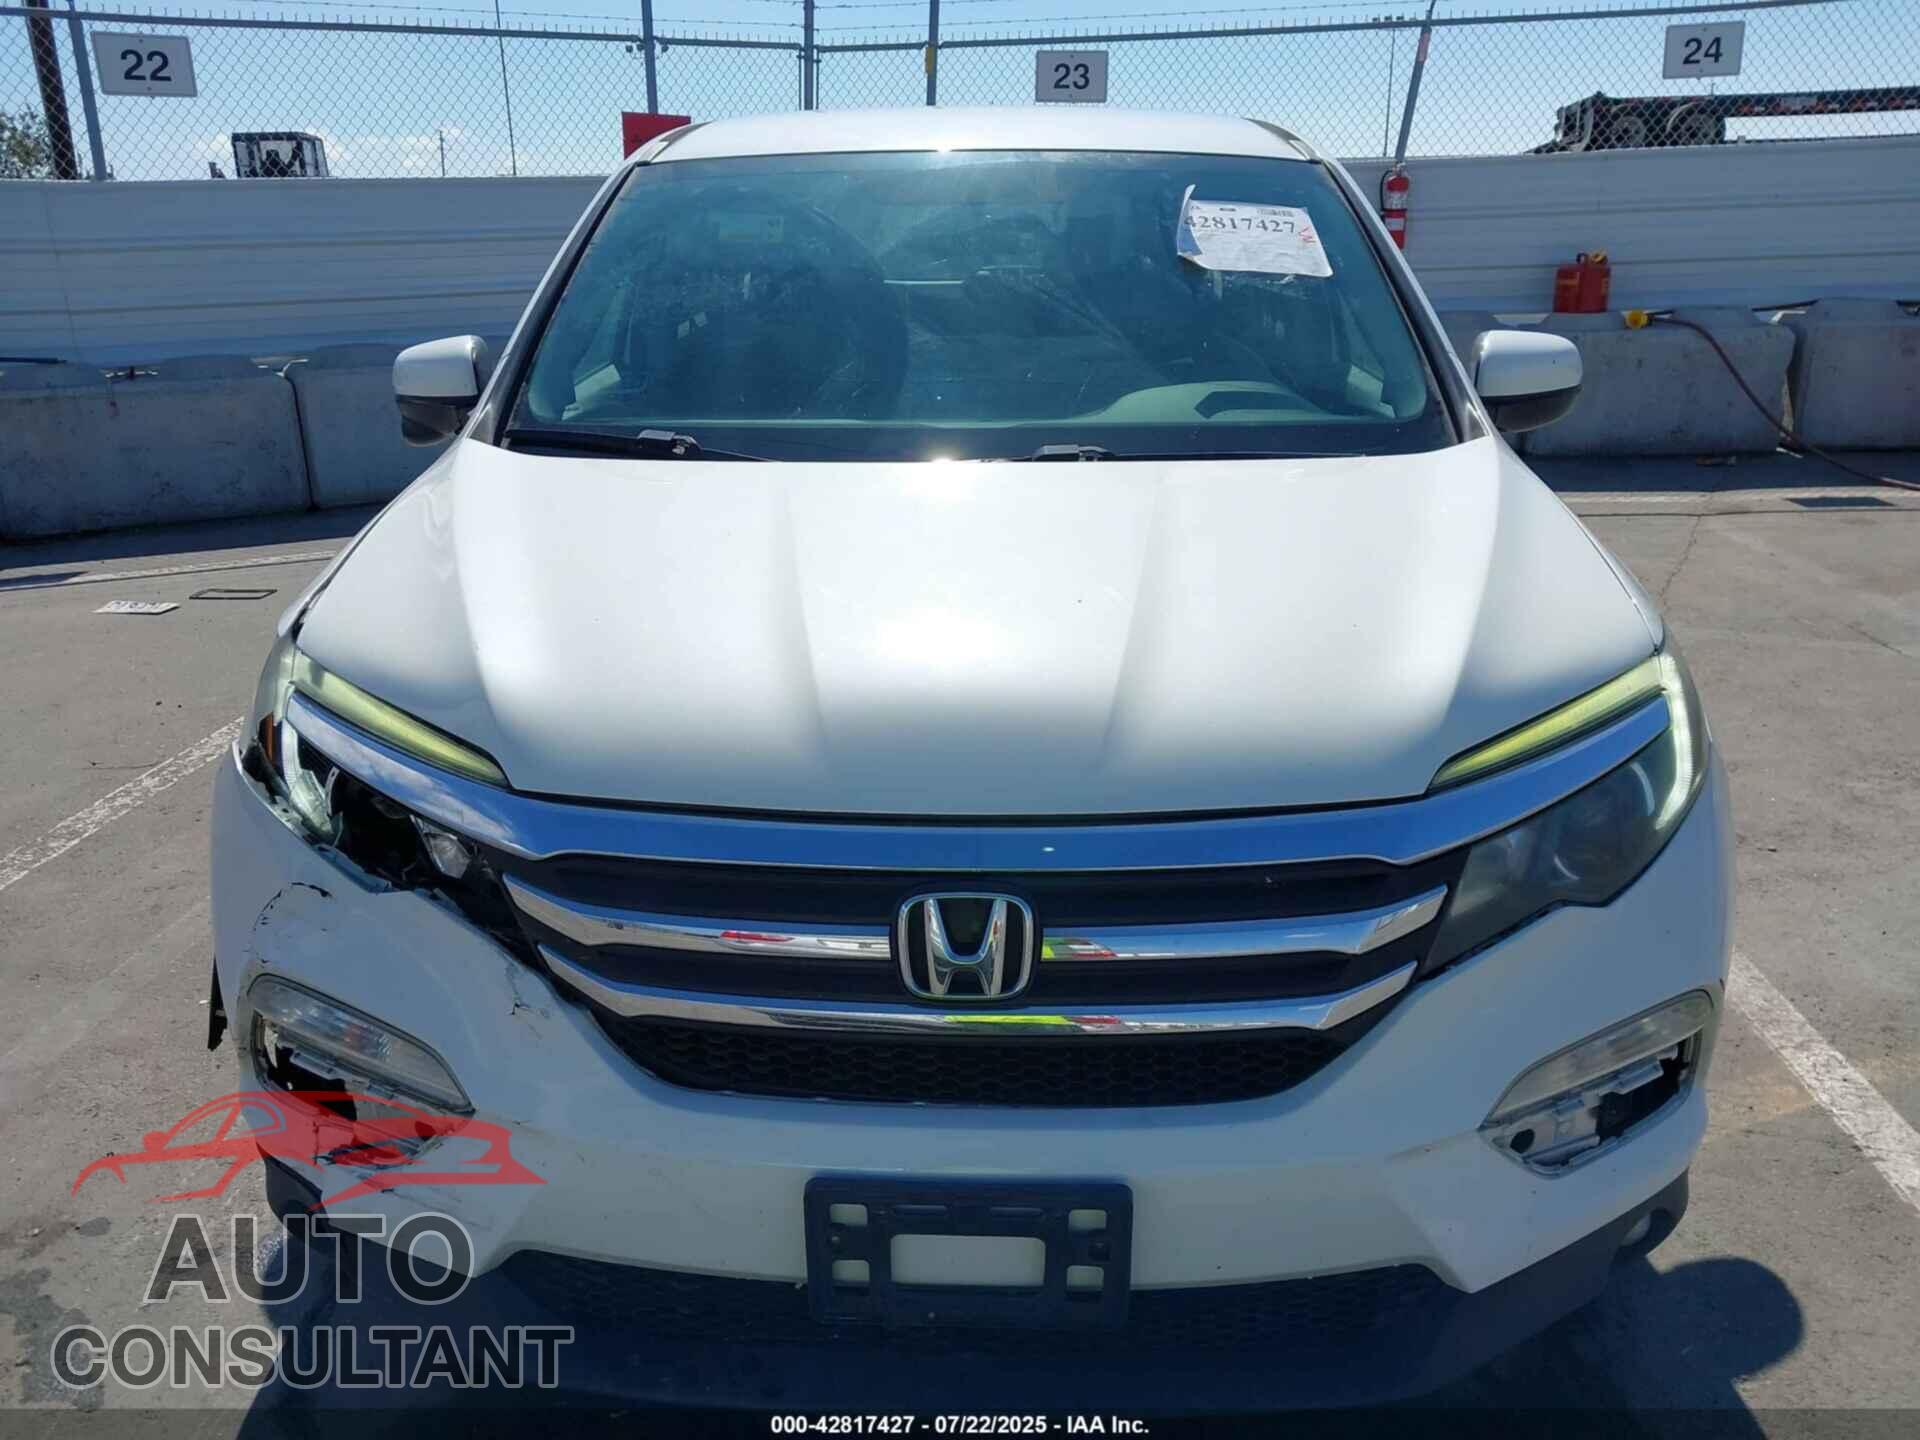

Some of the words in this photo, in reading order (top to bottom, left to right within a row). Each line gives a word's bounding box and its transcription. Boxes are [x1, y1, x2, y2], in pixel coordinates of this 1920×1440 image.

[1683, 36, 1723, 65] 24
[121, 49, 172, 82] 22
[1054, 63, 1090, 90] 23
[1184, 215, 1296, 234] 42817427
